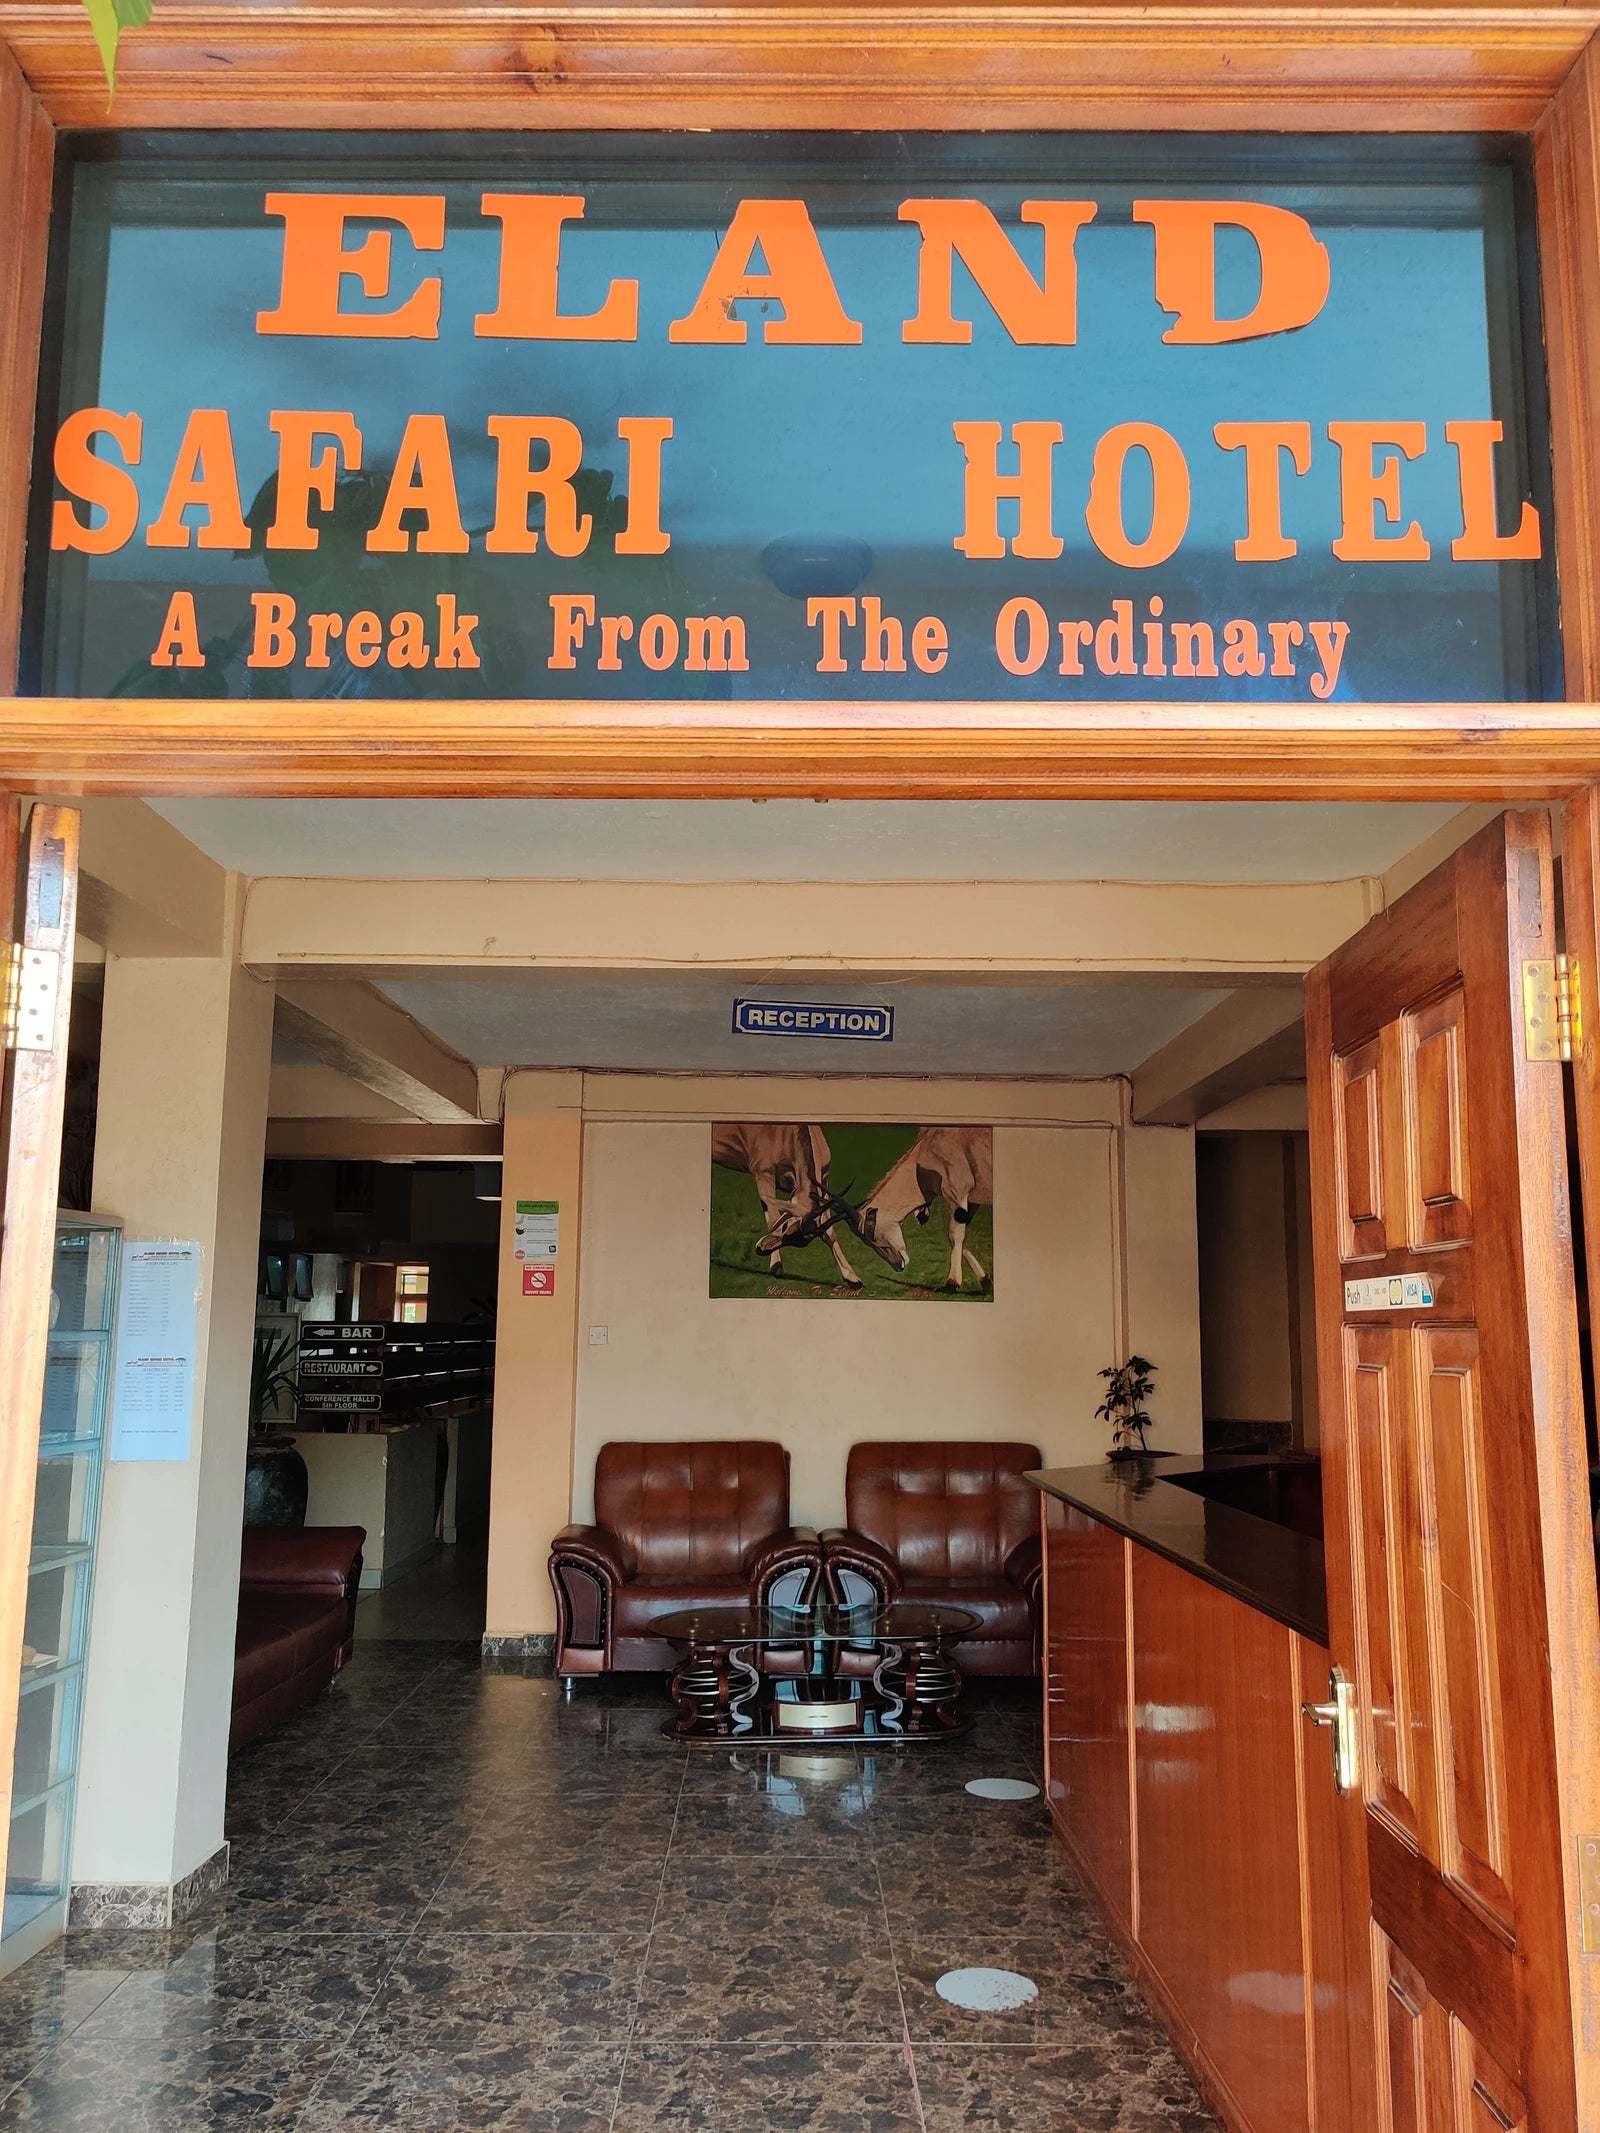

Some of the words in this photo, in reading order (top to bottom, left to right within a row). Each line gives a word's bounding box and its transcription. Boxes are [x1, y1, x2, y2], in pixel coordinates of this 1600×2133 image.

[255, 192, 1331, 345] ELAND
[50, 407, 673, 558] SAFARI
[953, 420, 1542, 568] HOTEL
[150, 591, 205, 668] A
[247, 592, 481, 671] Break
[548, 594, 749, 673] From
[807, 596, 949, 674] The
[996, 595, 1350, 698] Ordinary
[748, 1009, 879, 1031] RECEPTION
[1347, 1284, 1361, 1305] Push
[342, 1328, 372, 1338] BAR
[304, 1363, 366, 1373] RESTAURANT
